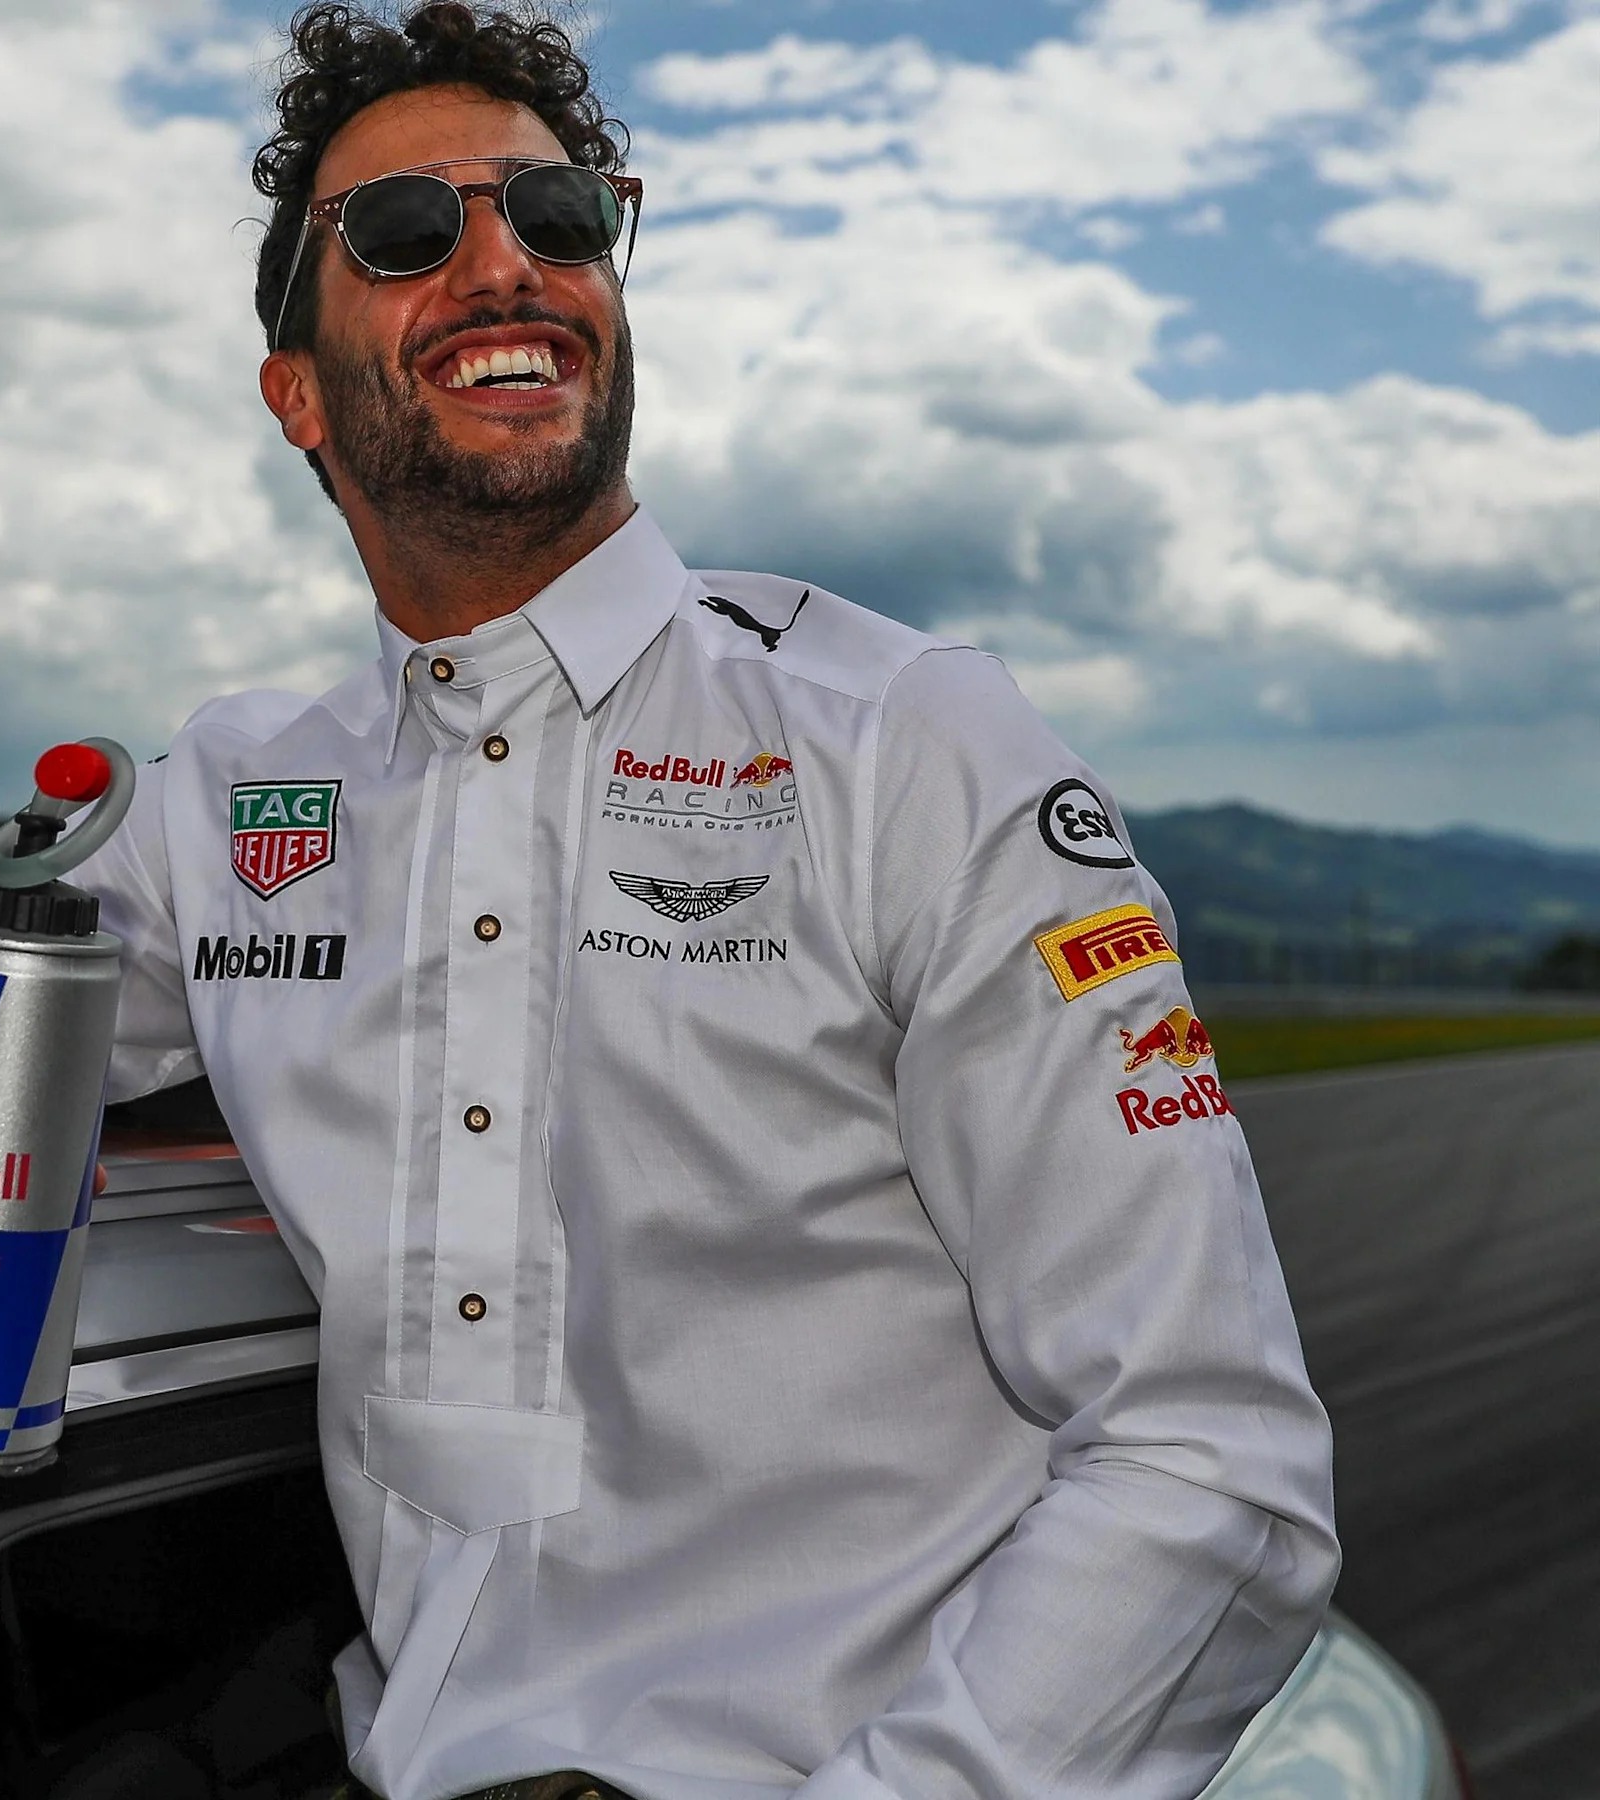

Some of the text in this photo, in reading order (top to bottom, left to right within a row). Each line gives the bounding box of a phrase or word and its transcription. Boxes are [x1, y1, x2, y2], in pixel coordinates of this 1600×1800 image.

[235, 792, 323, 825] TAG
[605, 780, 797, 813] RACING
[601, 810, 693, 829] FORMULA
[754, 813, 796, 831] TEAM
[1056, 803, 1118, 842] Ess
[234, 834, 323, 885] HEUER
[193, 935, 296, 980] Mobil
[578, 929, 787, 964] ASTON MARTIN
[1059, 916, 1179, 983] PIRE
